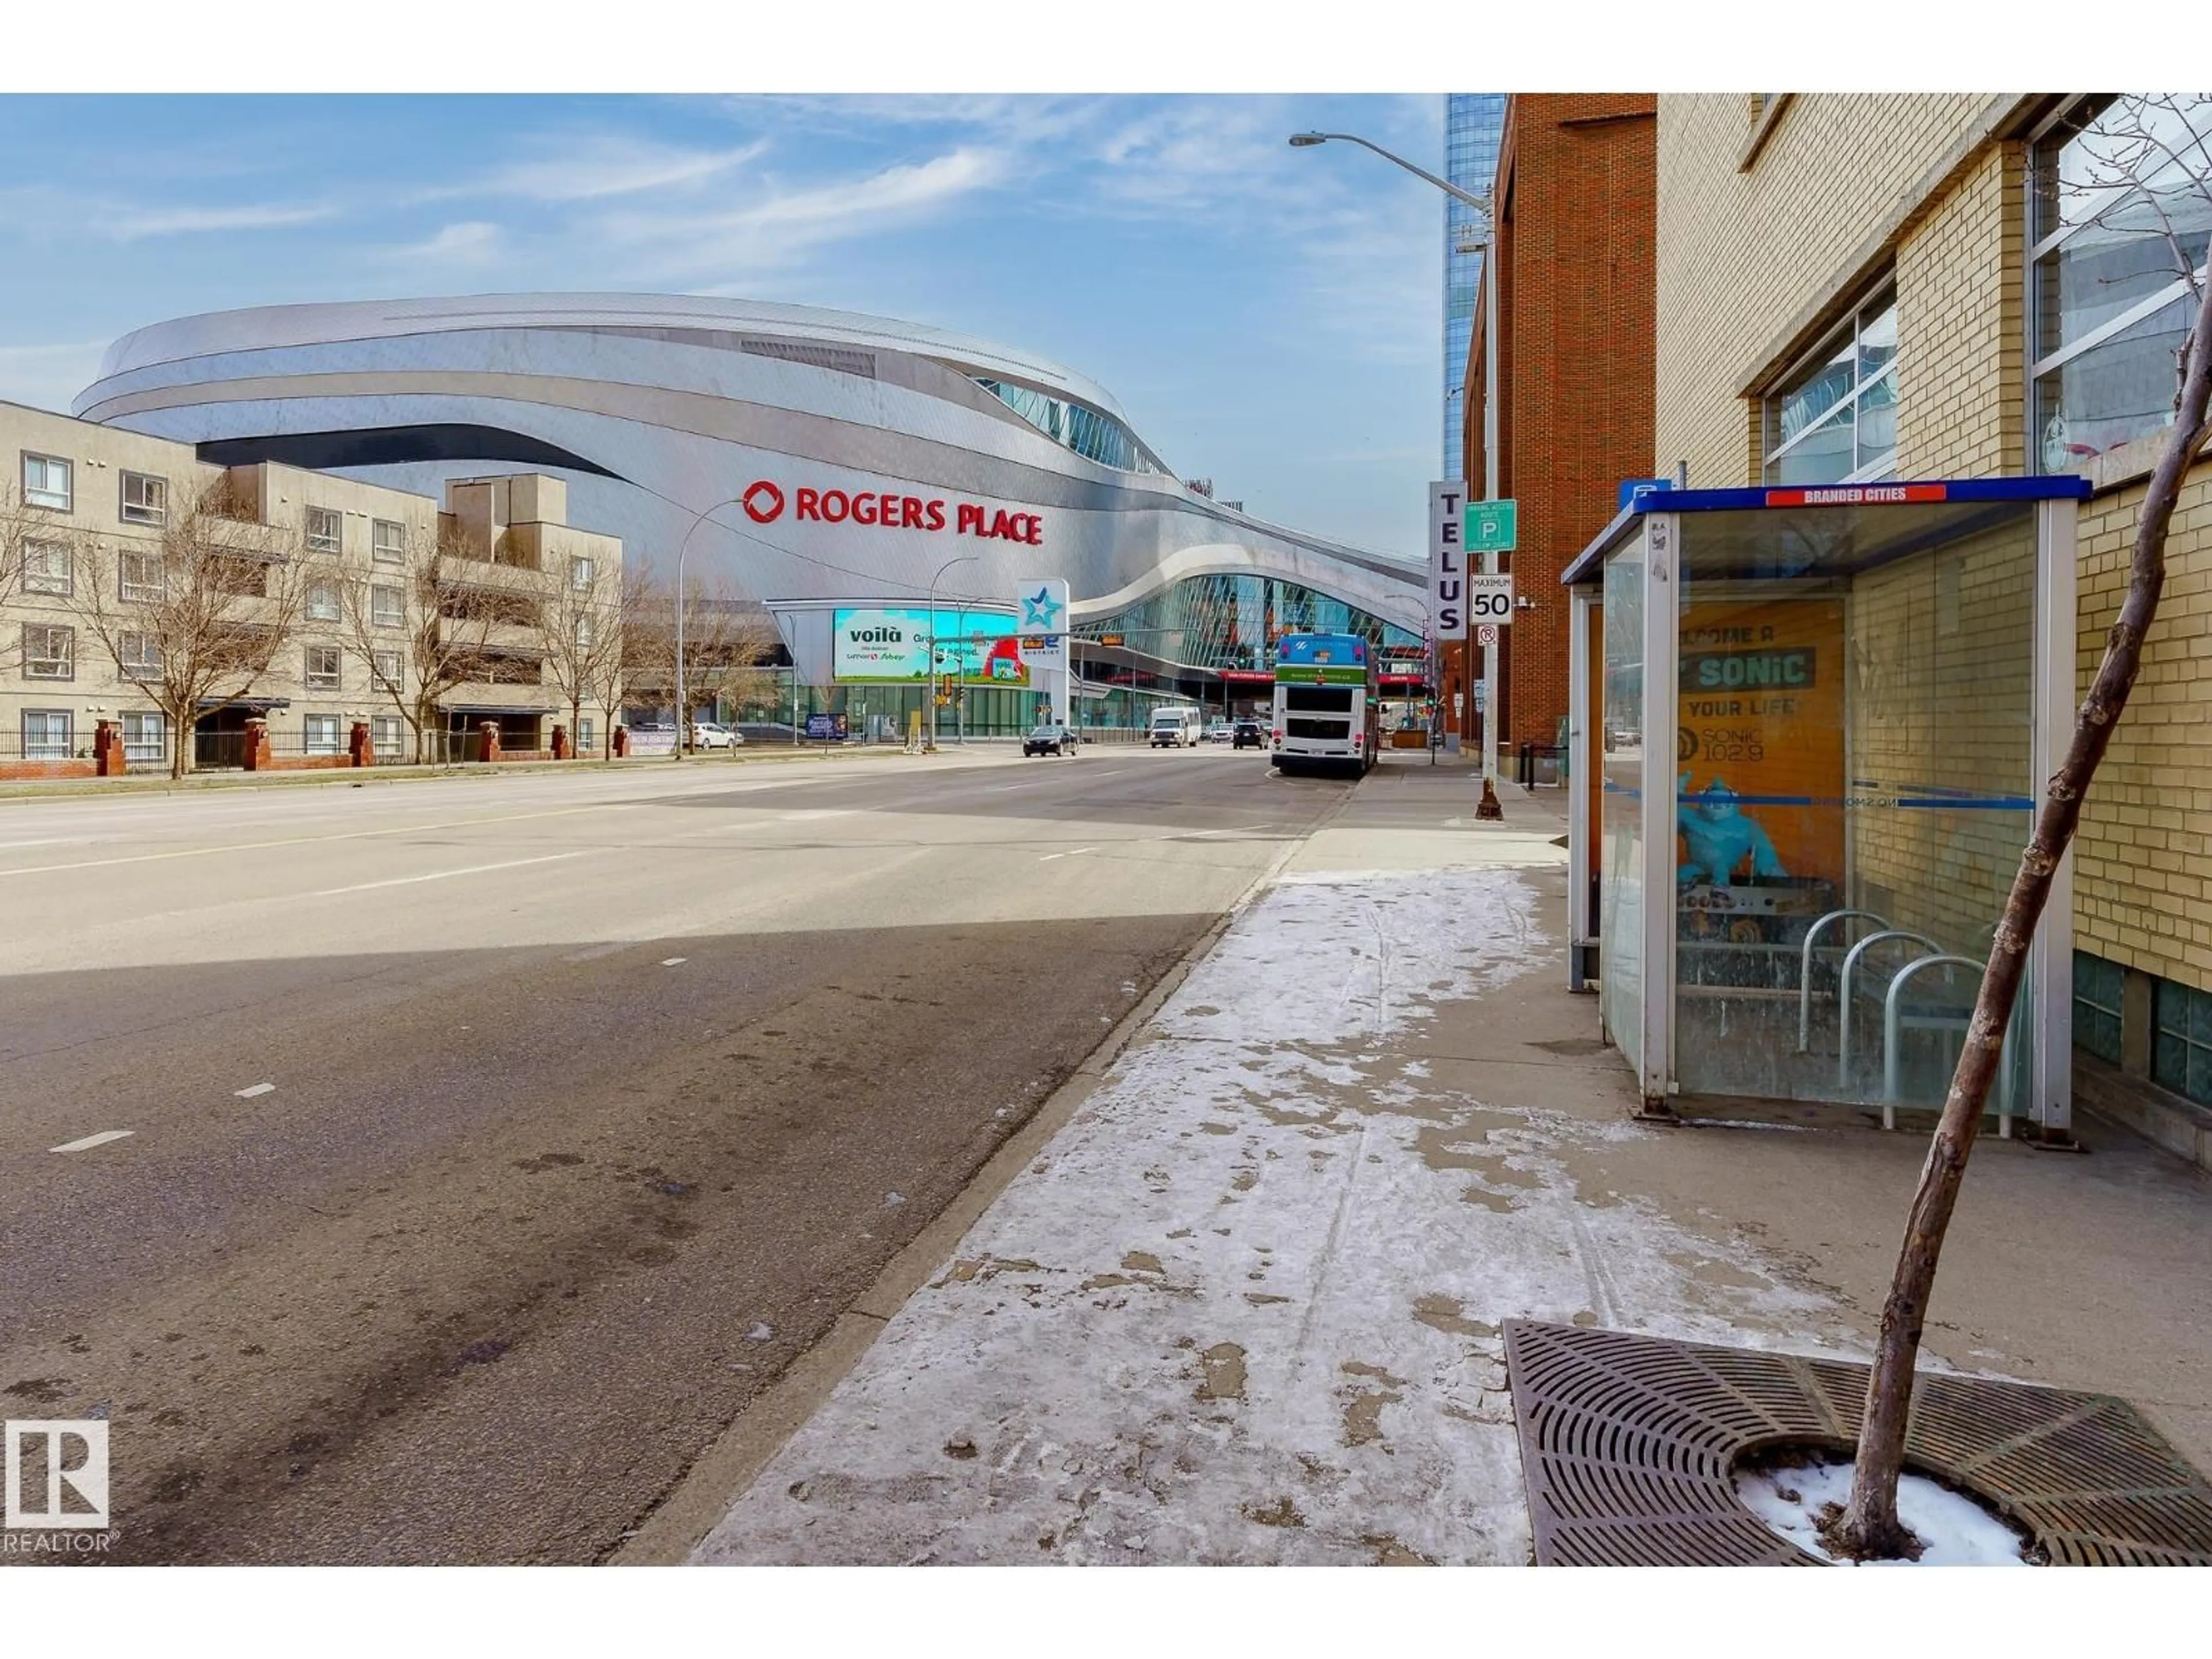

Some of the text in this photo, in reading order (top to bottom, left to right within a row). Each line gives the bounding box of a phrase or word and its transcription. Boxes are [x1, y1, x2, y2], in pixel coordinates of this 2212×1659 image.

[1804, 487, 1906, 503] BRANDED CITIES
[797, 488, 1043, 545] ROGERS PLACE
[1482, 522, 1497, 539] P
[1440, 494, 1460, 630] TELUS
[1474, 579, 1510, 587] MAXIMUM
[1475, 594, 1509, 616] 50
[850, 626, 902, 642] voilà
[1689, 699, 1794, 718] YOUR LIFE
